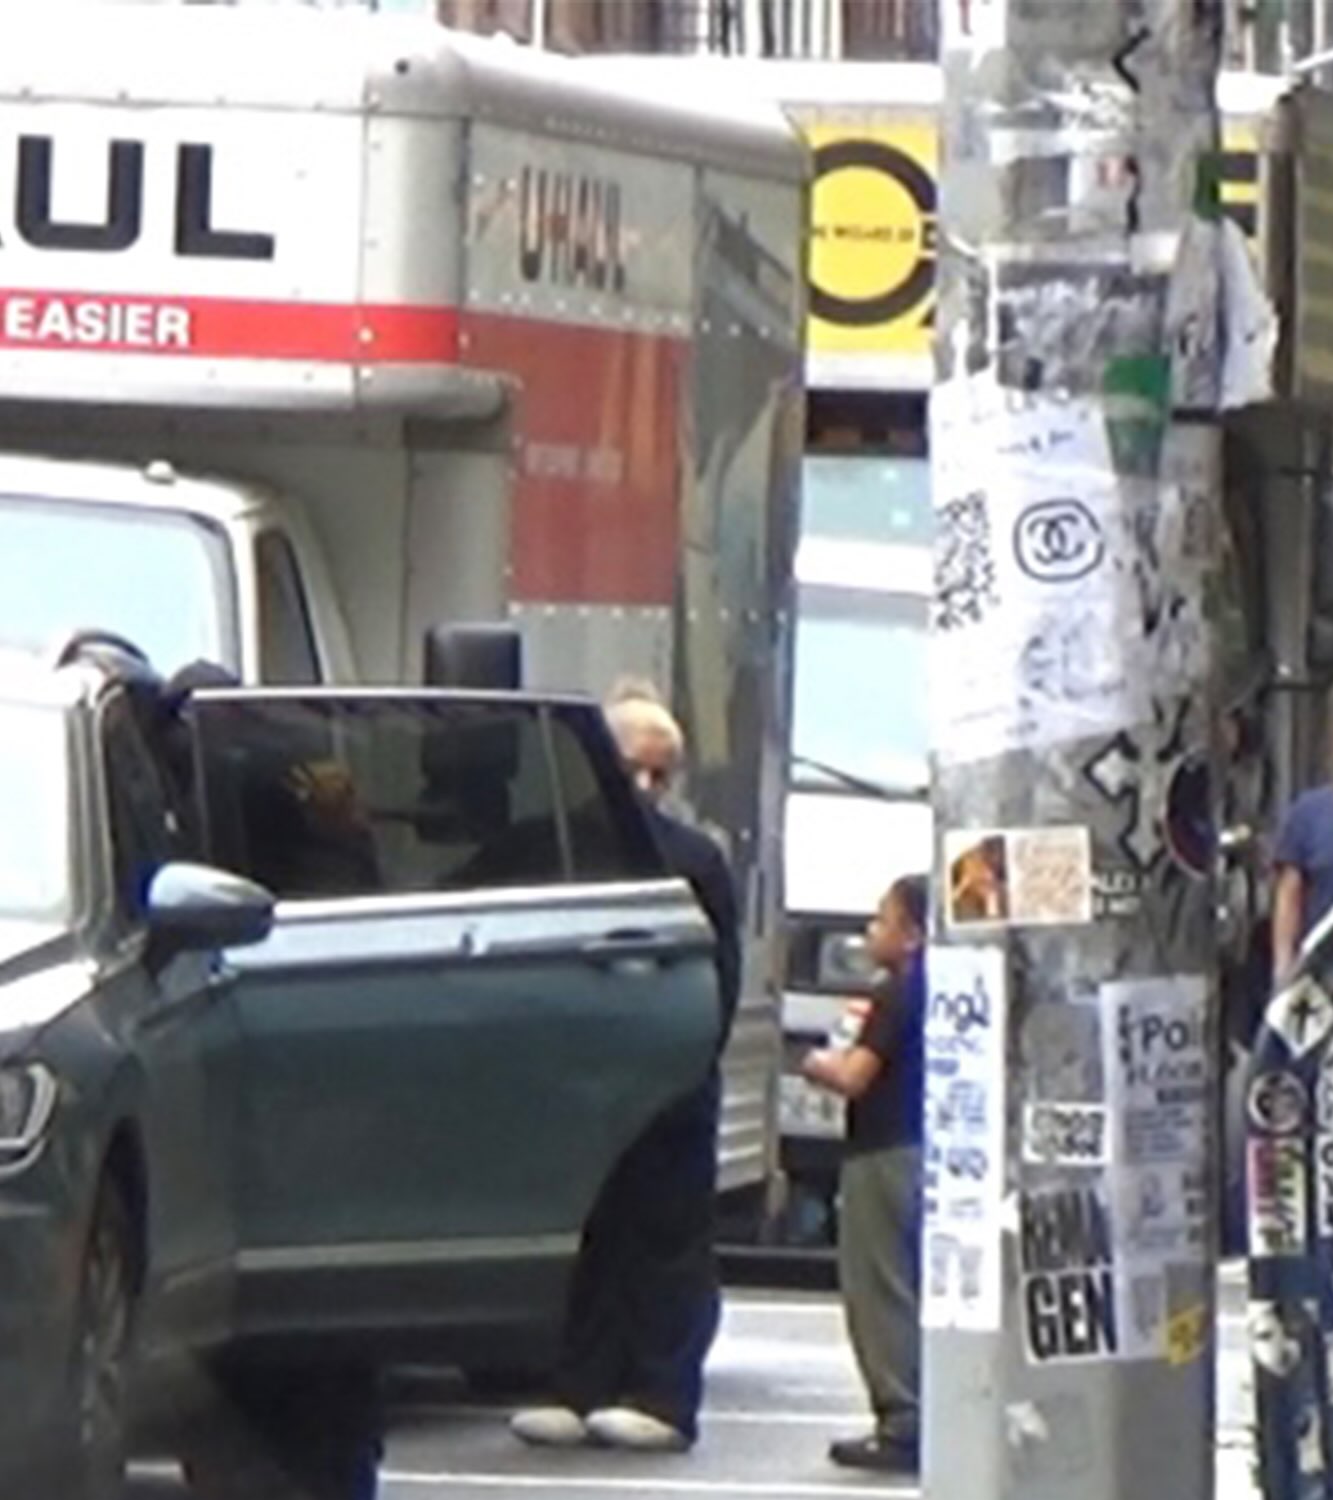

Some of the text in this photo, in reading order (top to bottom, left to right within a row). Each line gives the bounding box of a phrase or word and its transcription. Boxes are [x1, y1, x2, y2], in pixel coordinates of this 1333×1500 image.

[0, 134, 275, 261] UL
[4, 298, 192, 347] EASIER
[1026, 1271, 1117, 1359] GEN
